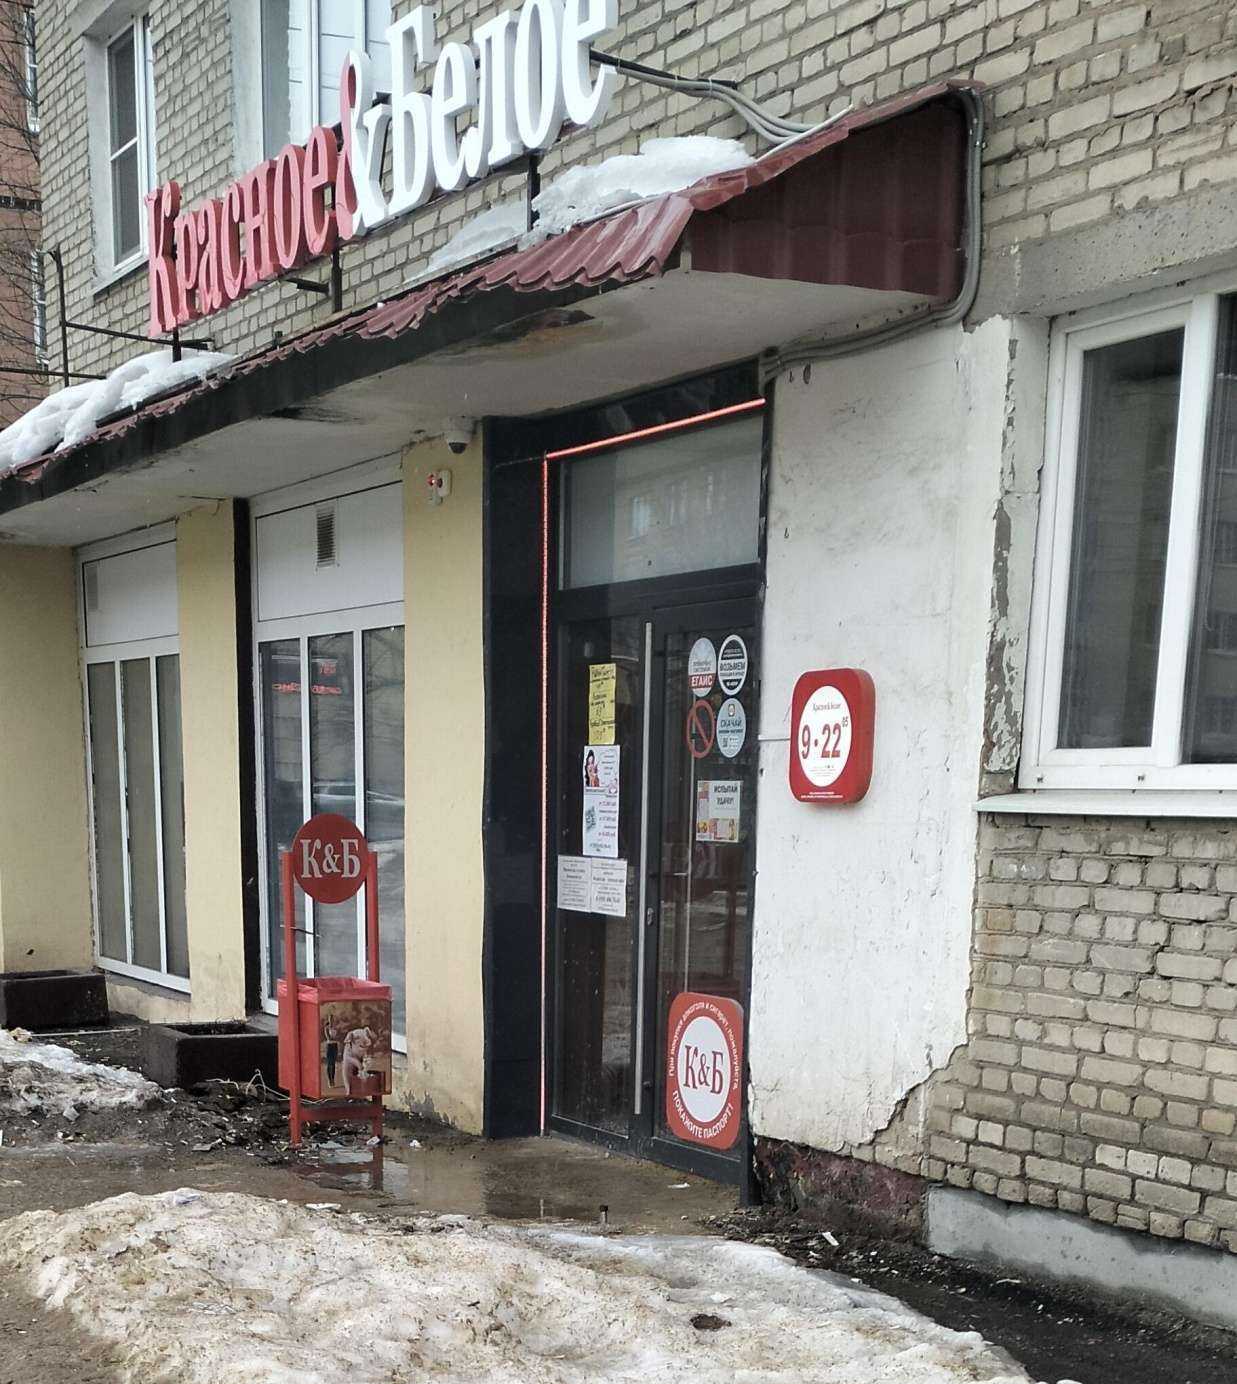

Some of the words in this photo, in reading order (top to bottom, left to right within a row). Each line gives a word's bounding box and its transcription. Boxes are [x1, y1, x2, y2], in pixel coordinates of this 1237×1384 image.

[691, 675, 713, 687] ЕГАИС
[300, 838, 361, 878] К&Б
[683, 1044, 724, 1095] К&Б
[672, 1090, 703, 1139] ПОКАЖИТЕ
